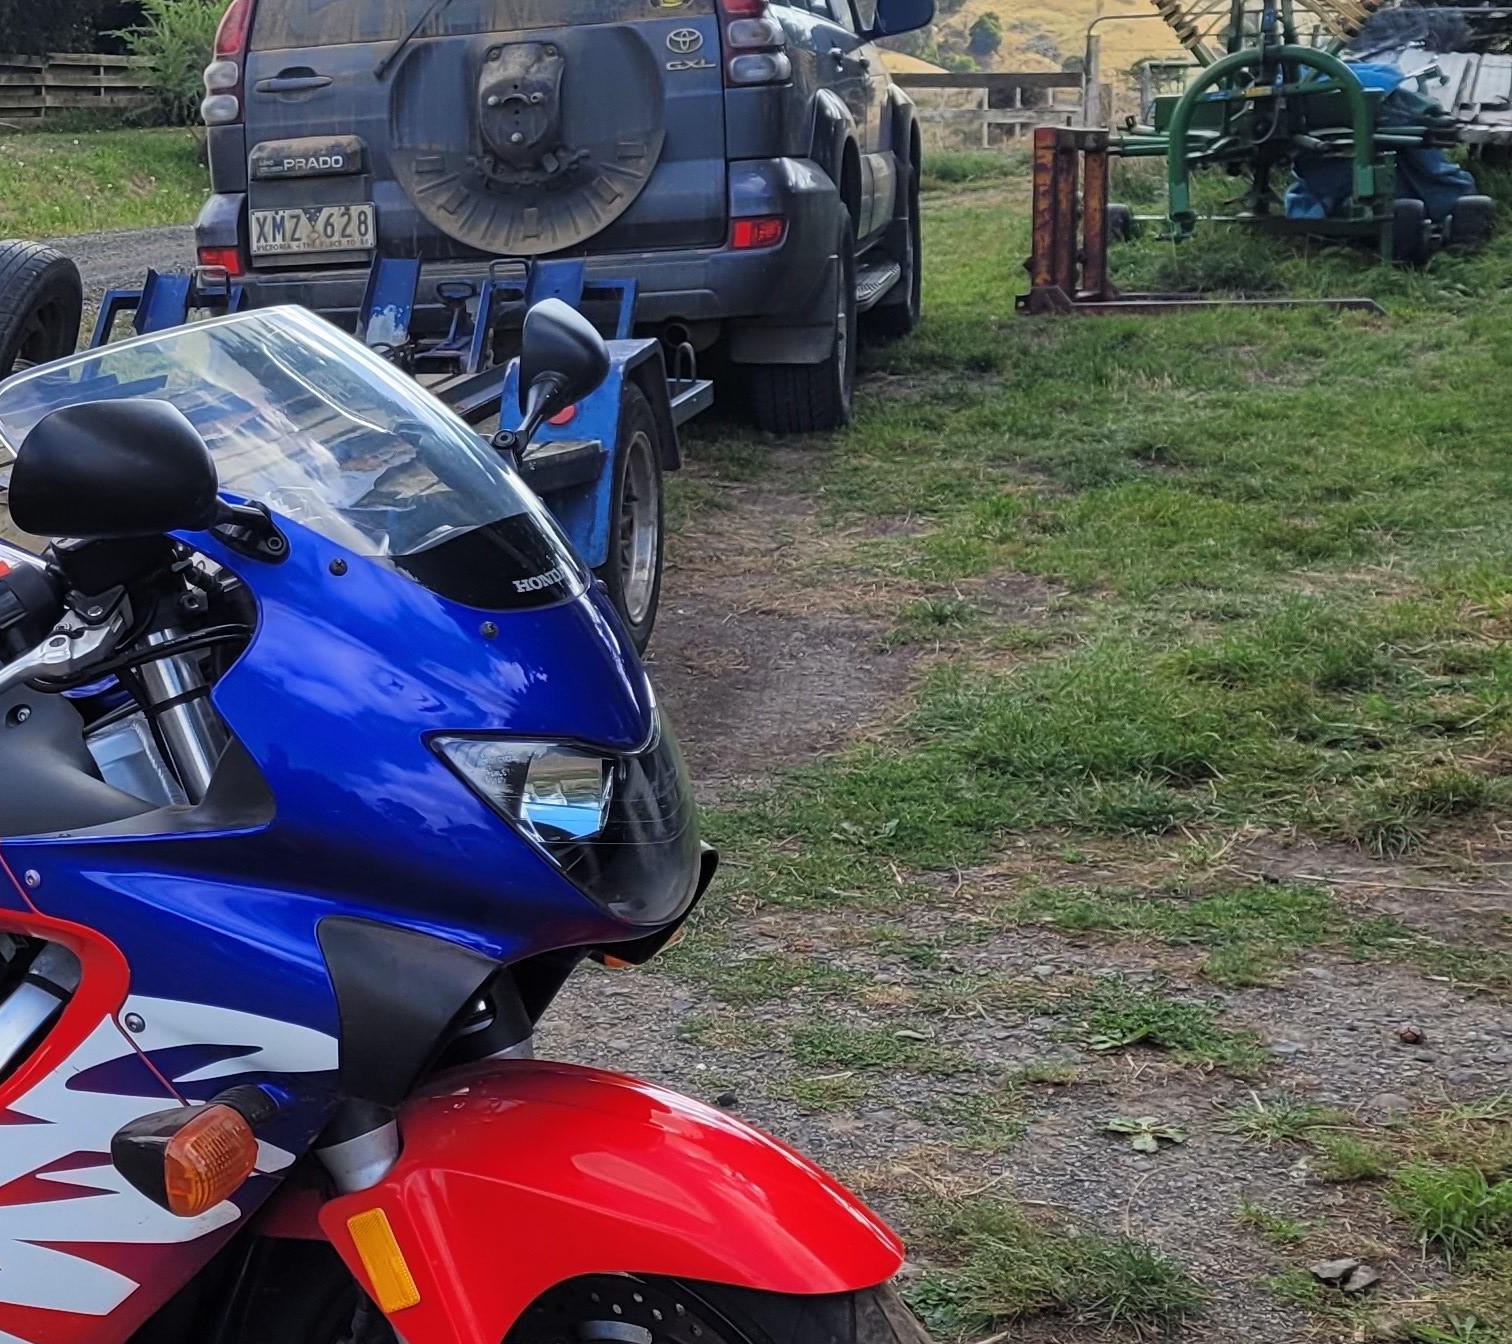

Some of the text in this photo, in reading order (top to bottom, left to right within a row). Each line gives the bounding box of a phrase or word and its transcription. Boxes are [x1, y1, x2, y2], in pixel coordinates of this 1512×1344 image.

[666, 58, 717, 71] GXL
[283, 155, 344, 171] PRADO
[256, 210, 369, 244] XMZ 628
[512, 567, 566, 593] HOND
